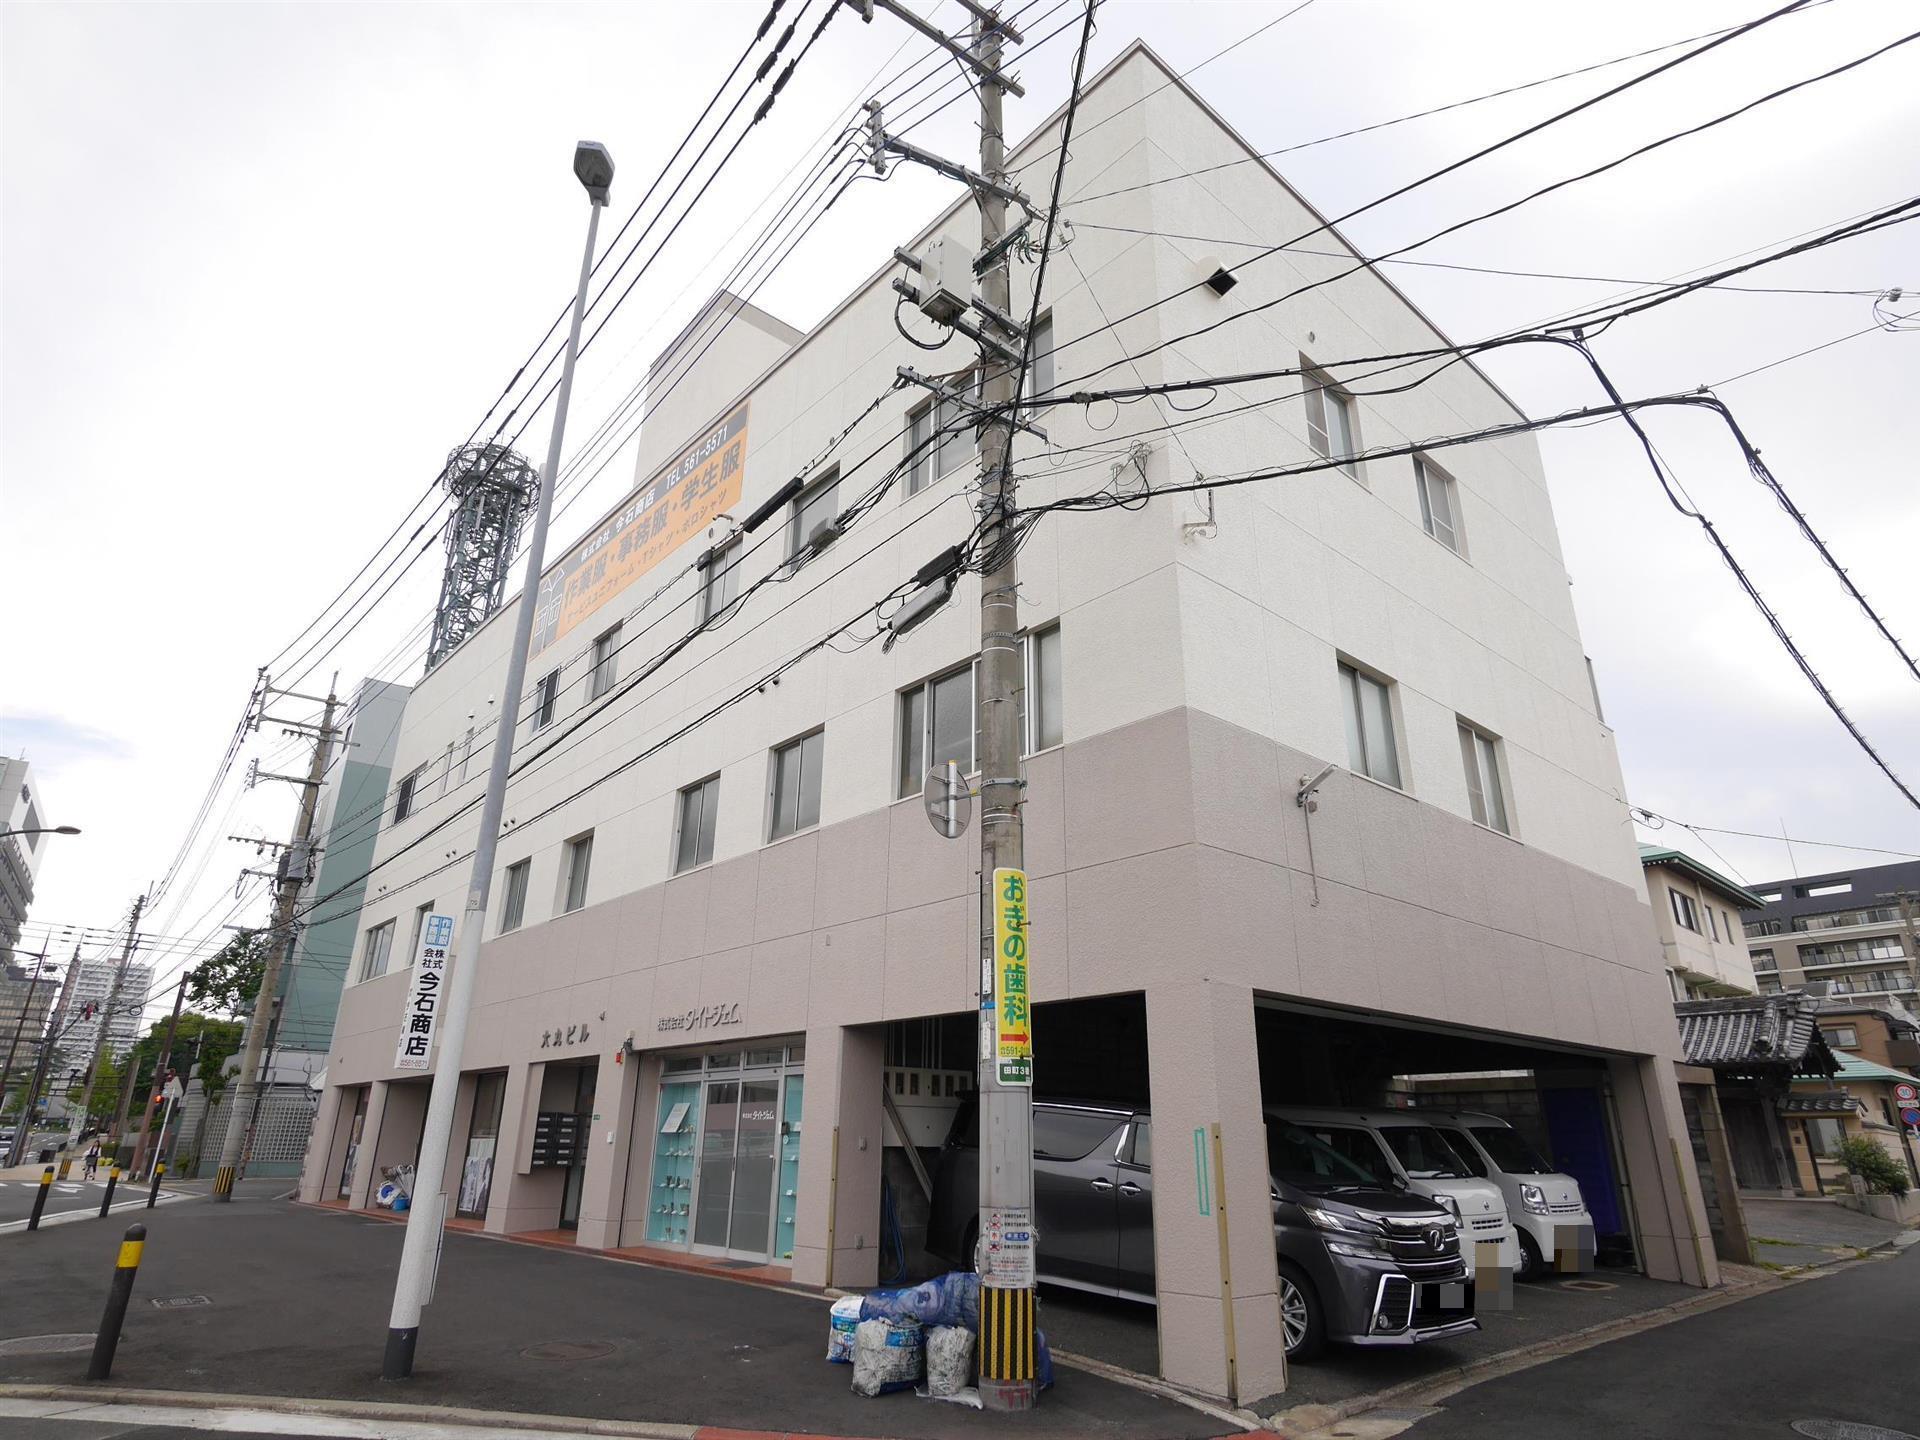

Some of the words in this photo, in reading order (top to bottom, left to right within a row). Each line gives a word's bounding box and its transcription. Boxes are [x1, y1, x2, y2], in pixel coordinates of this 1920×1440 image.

[666, 467, 682, 491] TEL
[684, 425, 729, 474] 561-5571
[1003, 875, 1028, 1026] おぎの歯科
[405, 971, 440, 1056] 今石商店
